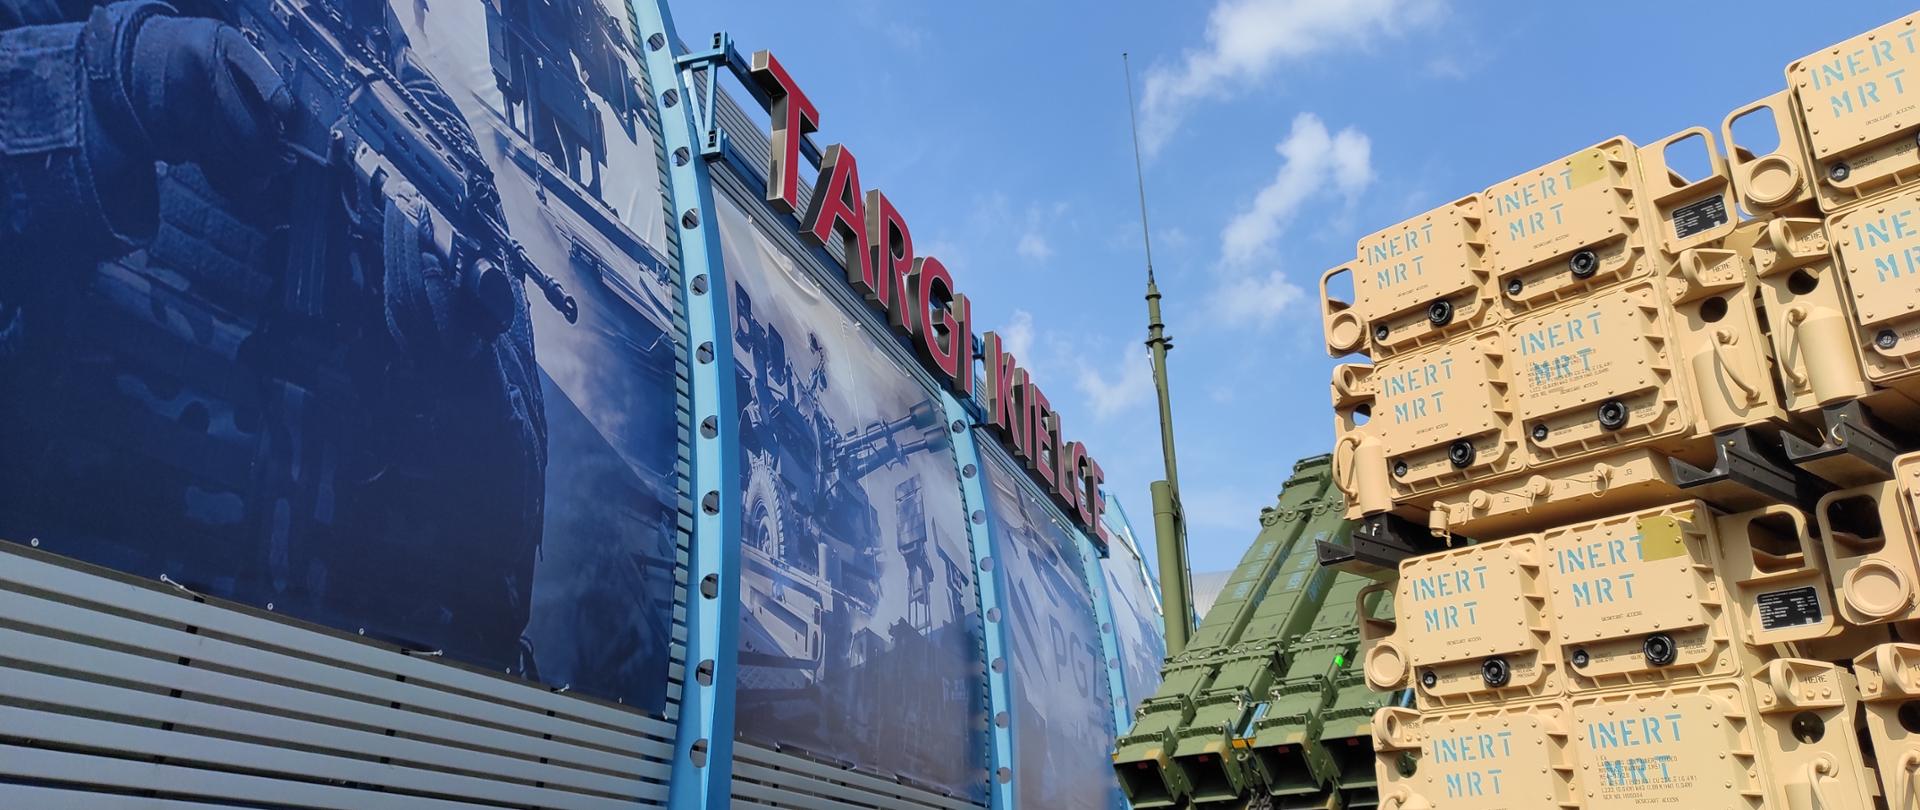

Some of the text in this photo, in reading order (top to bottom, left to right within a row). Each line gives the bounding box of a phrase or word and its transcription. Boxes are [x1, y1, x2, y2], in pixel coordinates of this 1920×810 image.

[1810, 28, 1917, 91] INERT
[1830, 69, 1905, 118] MRT
[1497, 168, 1573, 216] INERT
[1509, 203, 1564, 241] MRT
[1853, 207, 1920, 251] INE
[1367, 223, 1434, 266] INERT
[1377, 256, 1424, 290] MRT
[1875, 245, 1920, 283] MR
[752, 50, 1110, 545] TARGI KIELCE
[1520, 311, 1602, 356] INERT
[1384, 358, 1454, 398] INERT
[1534, 347, 1593, 385] MRT
[1395, 391, 1444, 424] MRT
[1557, 534, 1646, 575] INERT
[1413, 565, 1488, 602] INERT
[1572, 573, 1635, 608] MRT
[1425, 601, 1478, 633] MRT
[1433, 731, 1512, 764] INERT
[1588, 713, 1682, 750] INERT
[1446, 769, 1502, 798] MRT
[1604, 755, 1671, 786] MRT
